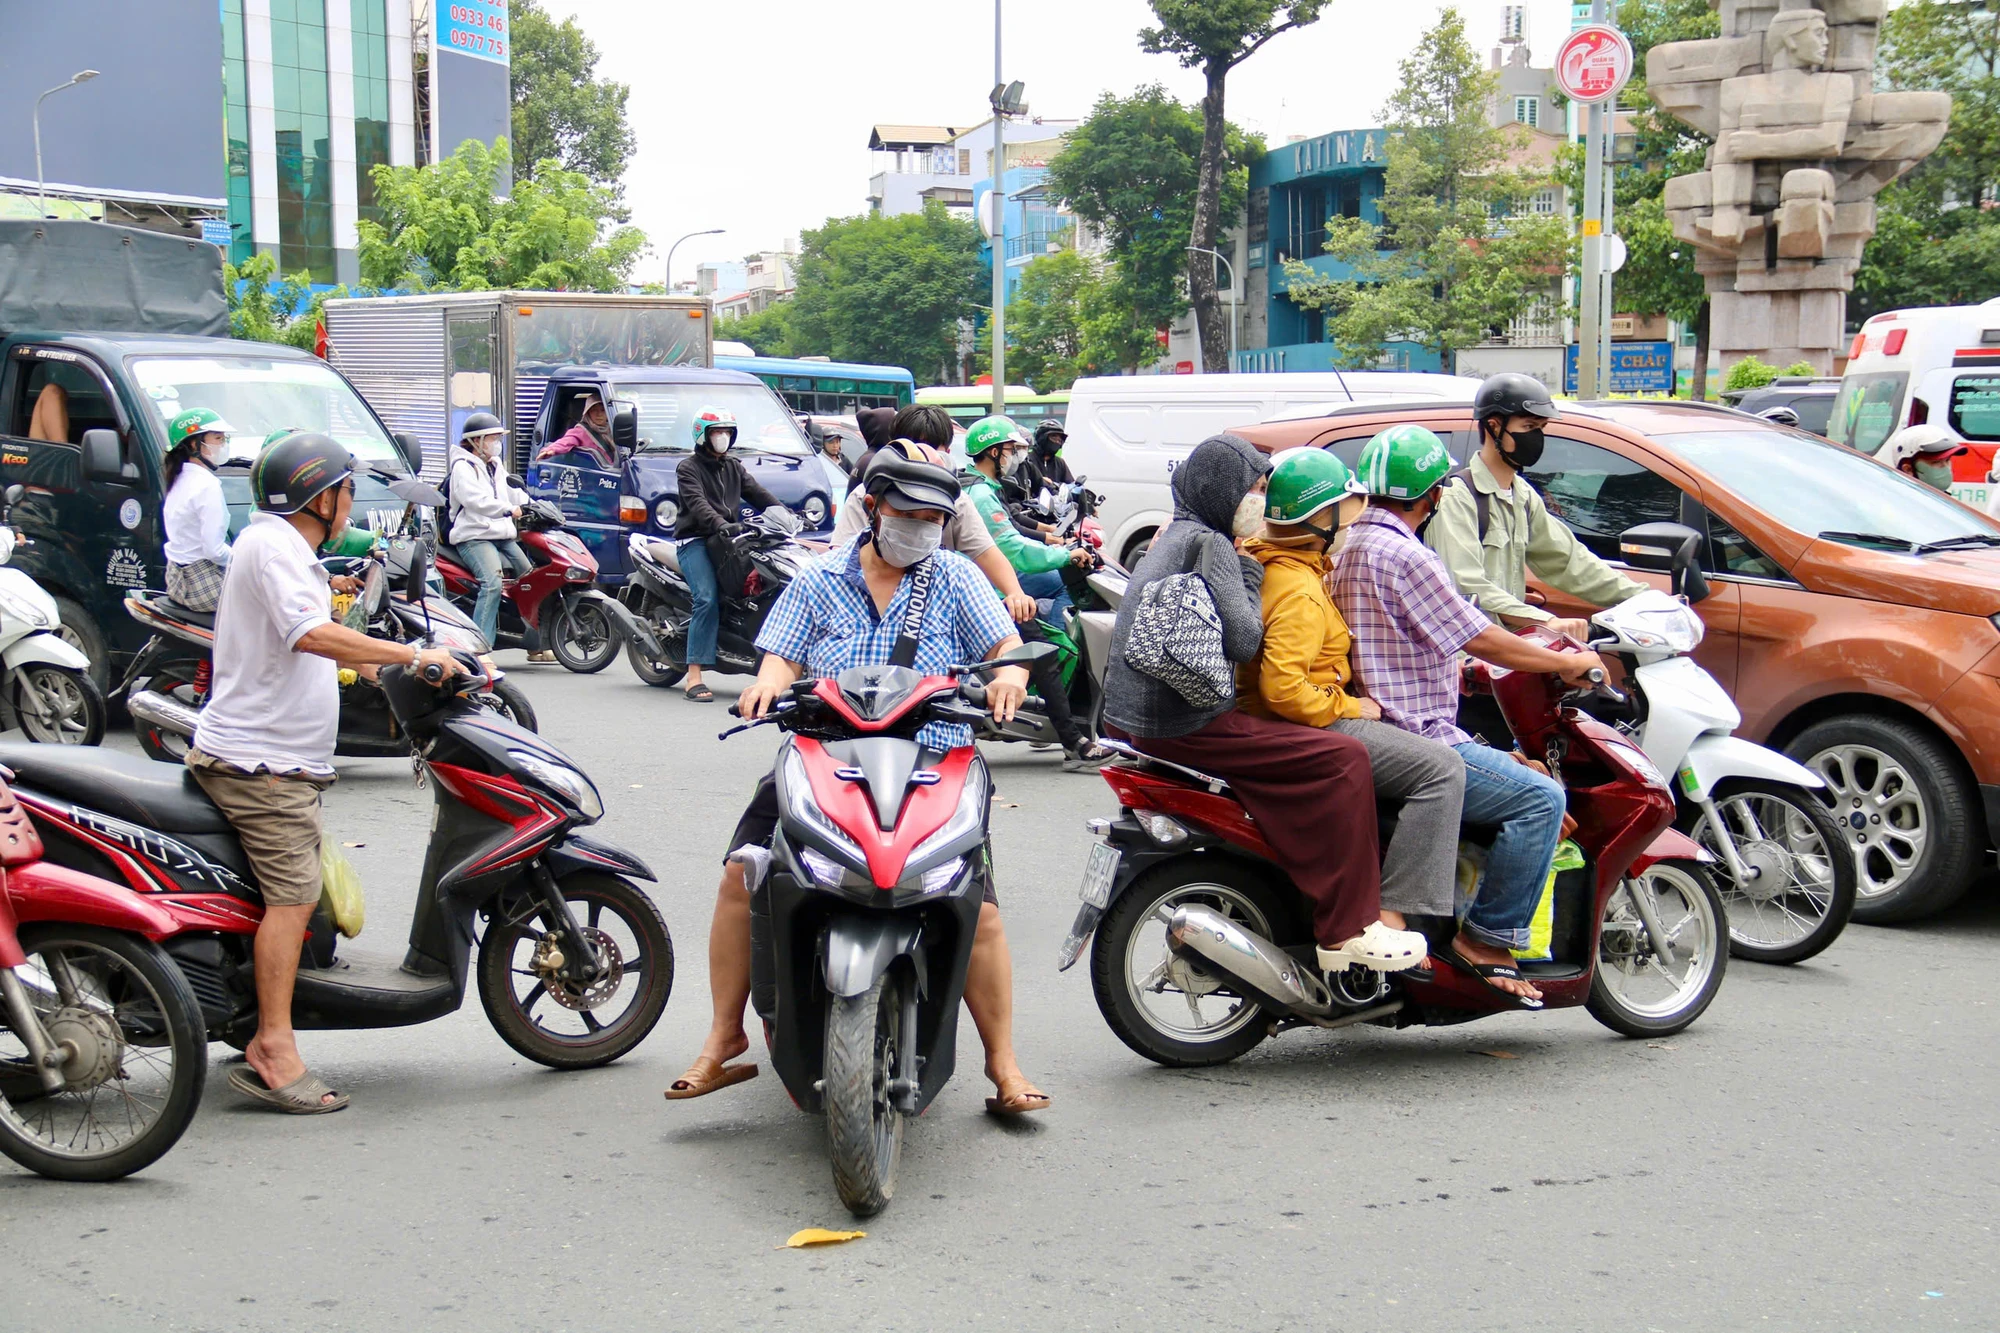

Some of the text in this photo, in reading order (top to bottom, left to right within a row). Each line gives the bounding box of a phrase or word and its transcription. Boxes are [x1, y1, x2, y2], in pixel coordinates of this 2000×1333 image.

[451, 5, 484, 26] 0933
[451, 29, 484, 50] 0977
[1295, 131, 1405, 173] KATINA
[178, 416, 202, 429] Grab
[978, 431, 1000, 443] Grab
[2, 444, 29, 452] FRONTIER
[2, 453, 28, 465] K200
[1415, 445, 1443, 472] Grab
